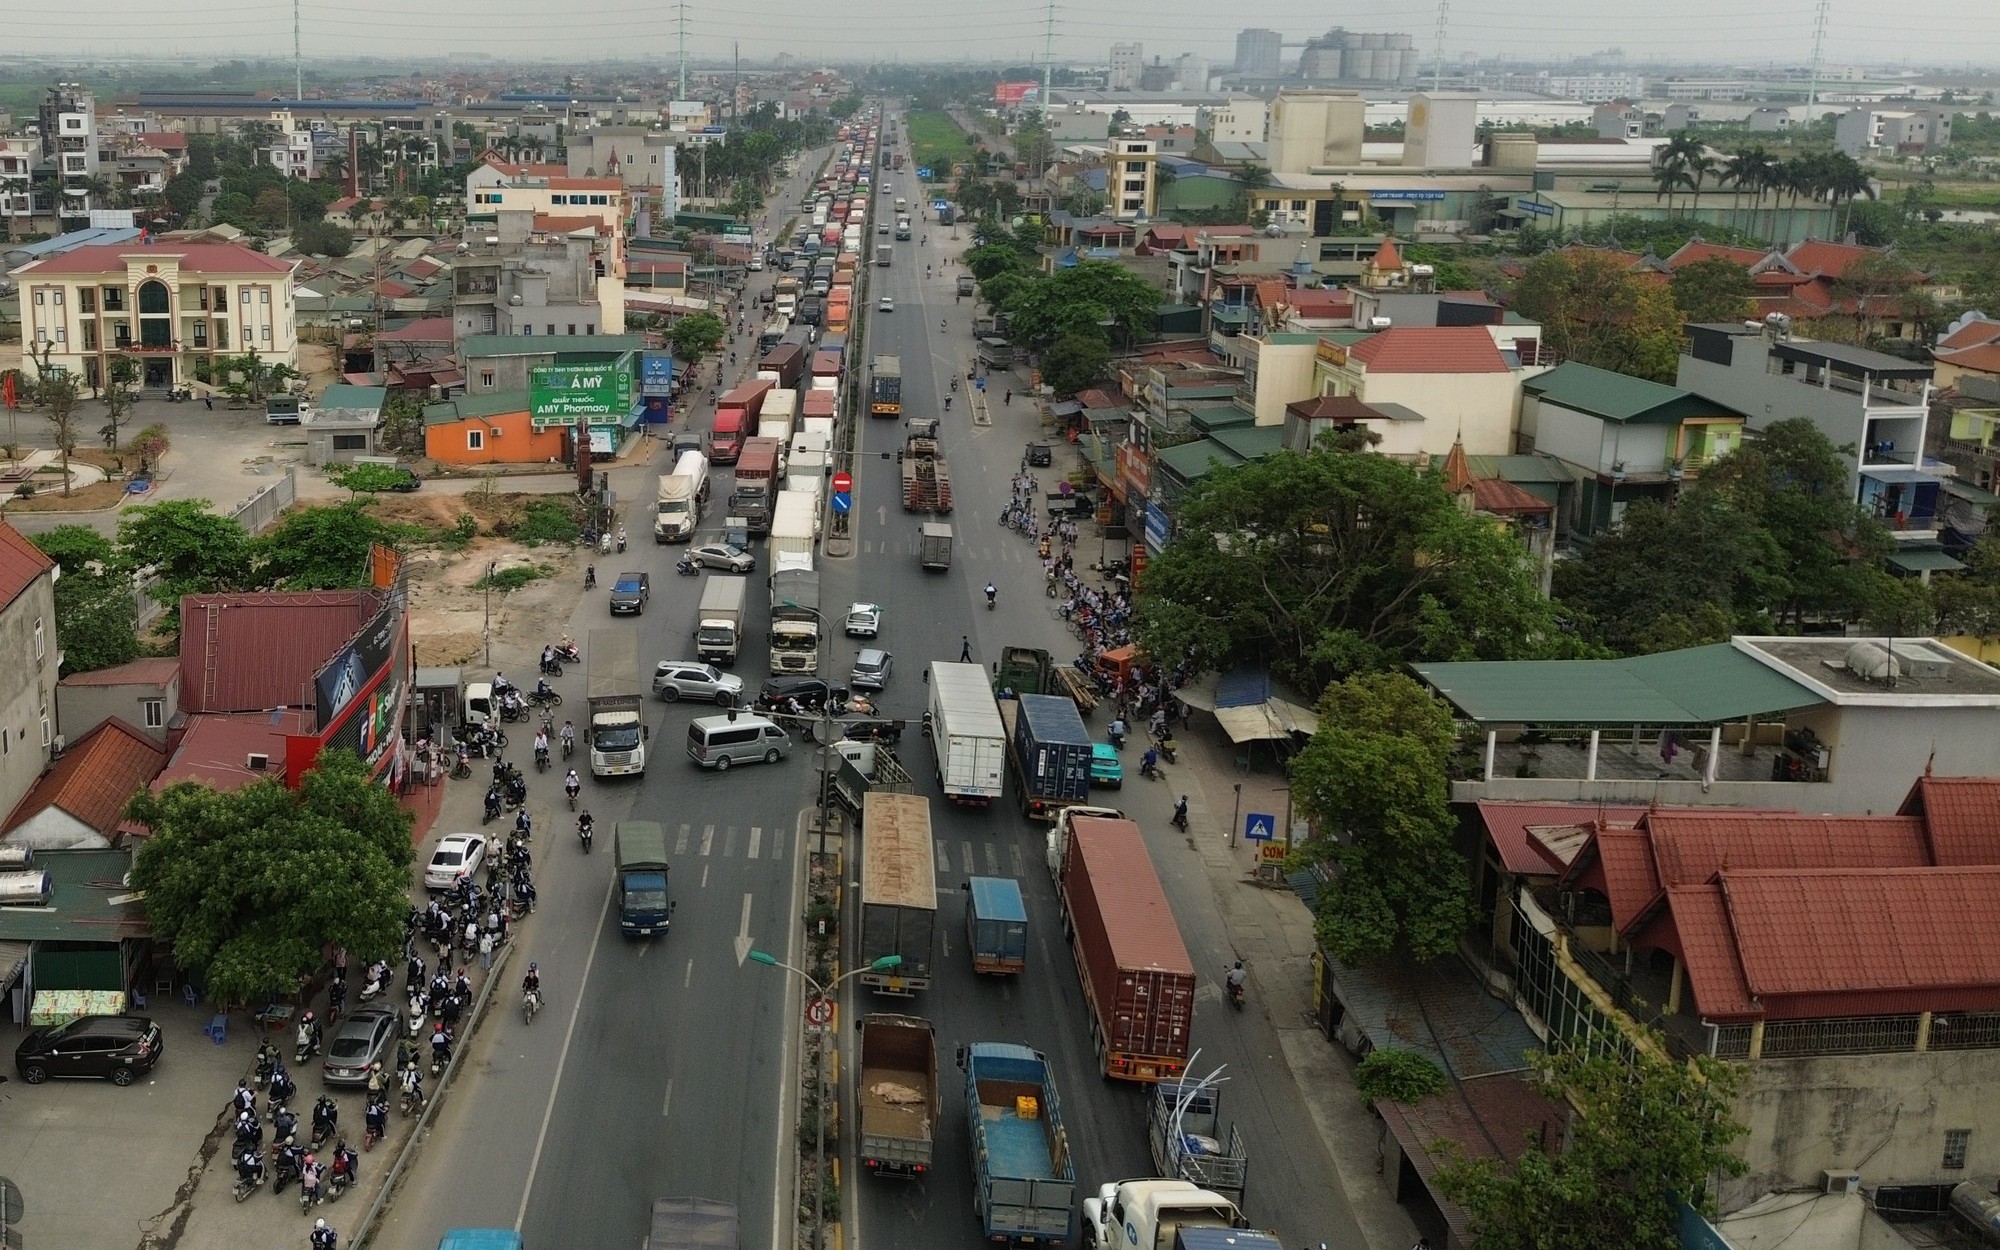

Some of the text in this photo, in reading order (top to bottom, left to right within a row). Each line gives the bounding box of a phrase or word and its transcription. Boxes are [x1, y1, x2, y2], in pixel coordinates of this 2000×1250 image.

[571, 374, 581, 389] Á
[583, 375, 603, 389] MỸ
[537, 405, 559, 414] AMY
[564, 404, 610, 414] Pharmacy
